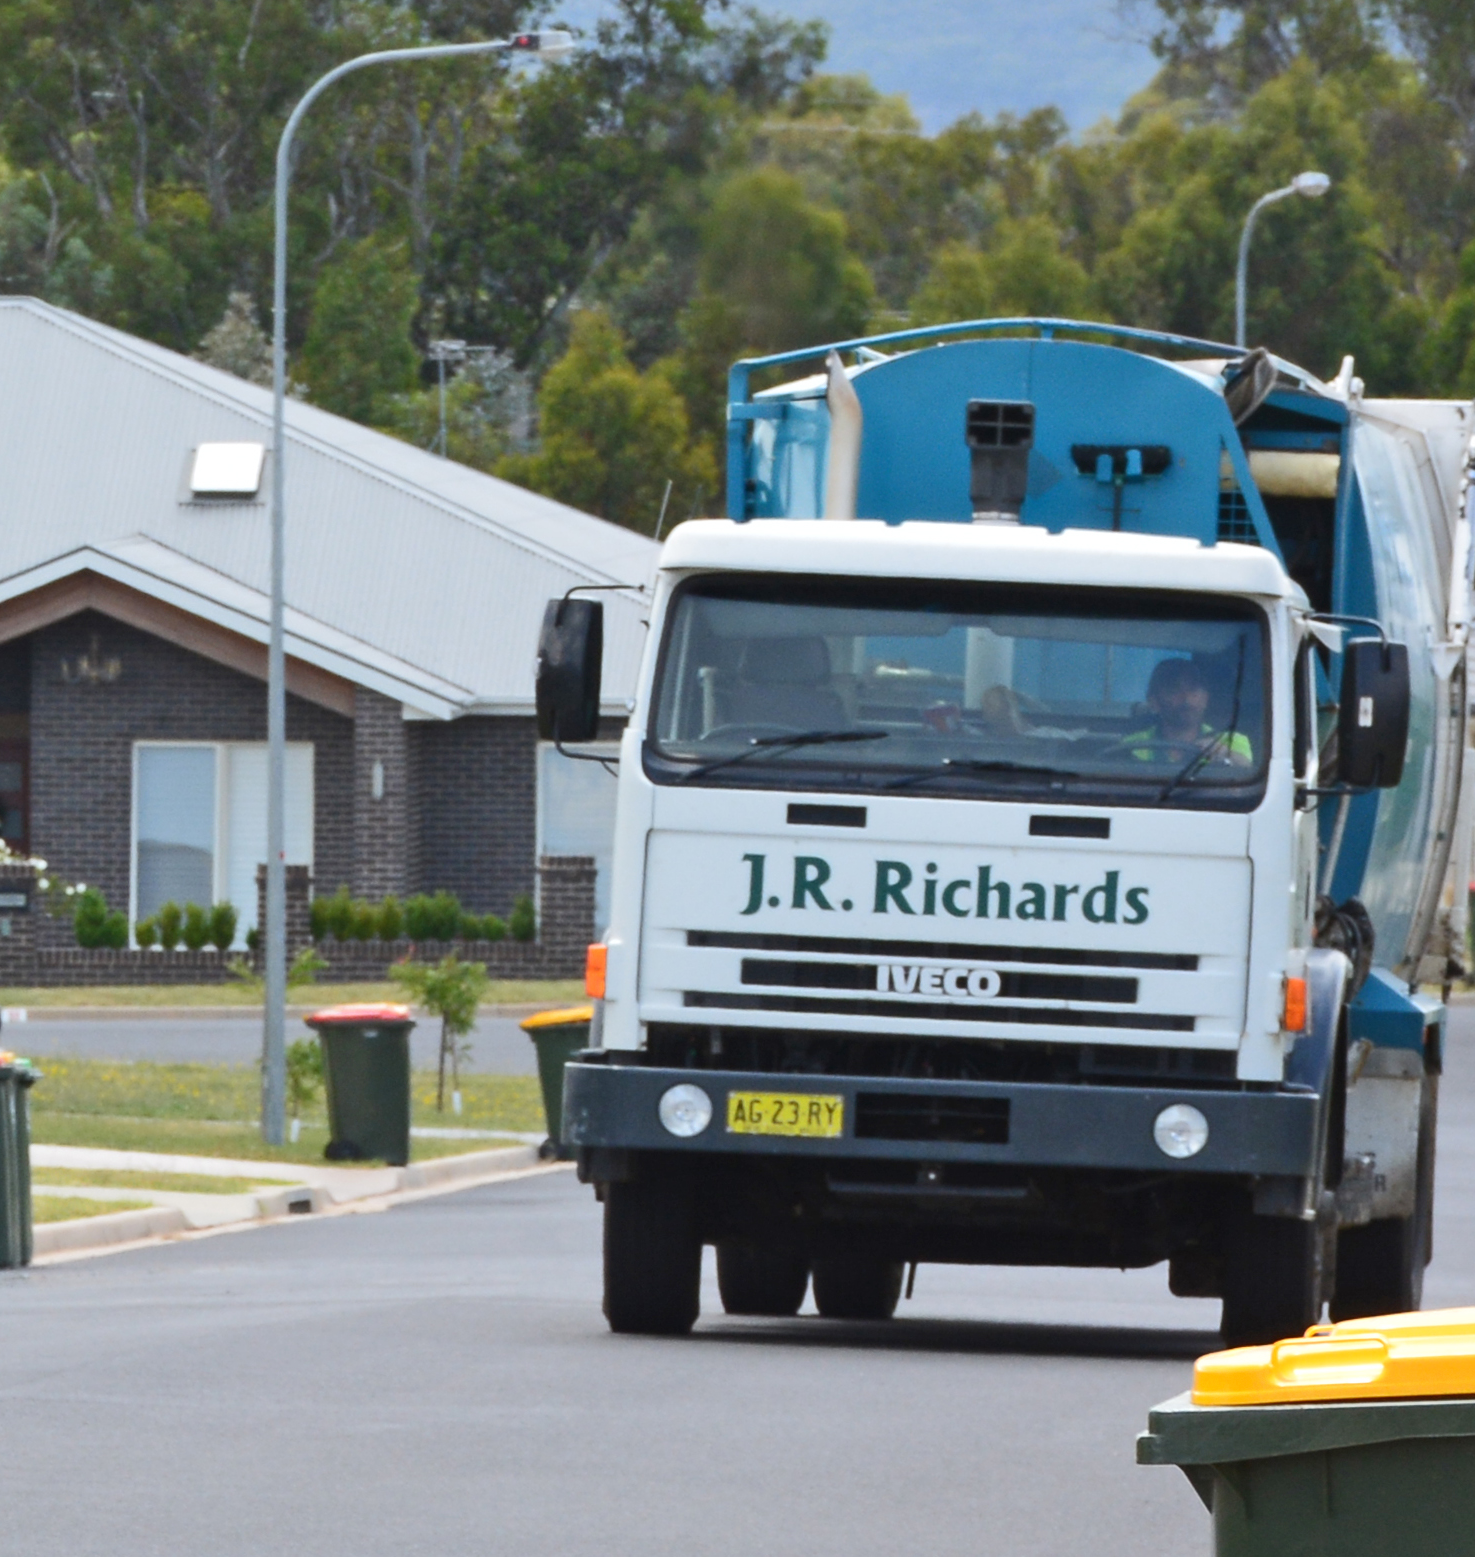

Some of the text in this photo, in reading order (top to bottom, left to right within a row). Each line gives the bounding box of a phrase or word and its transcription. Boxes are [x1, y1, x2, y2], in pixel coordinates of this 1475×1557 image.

[739, 853, 1150, 925] J.R. Richards
[876, 965, 1002, 998] IVECO
